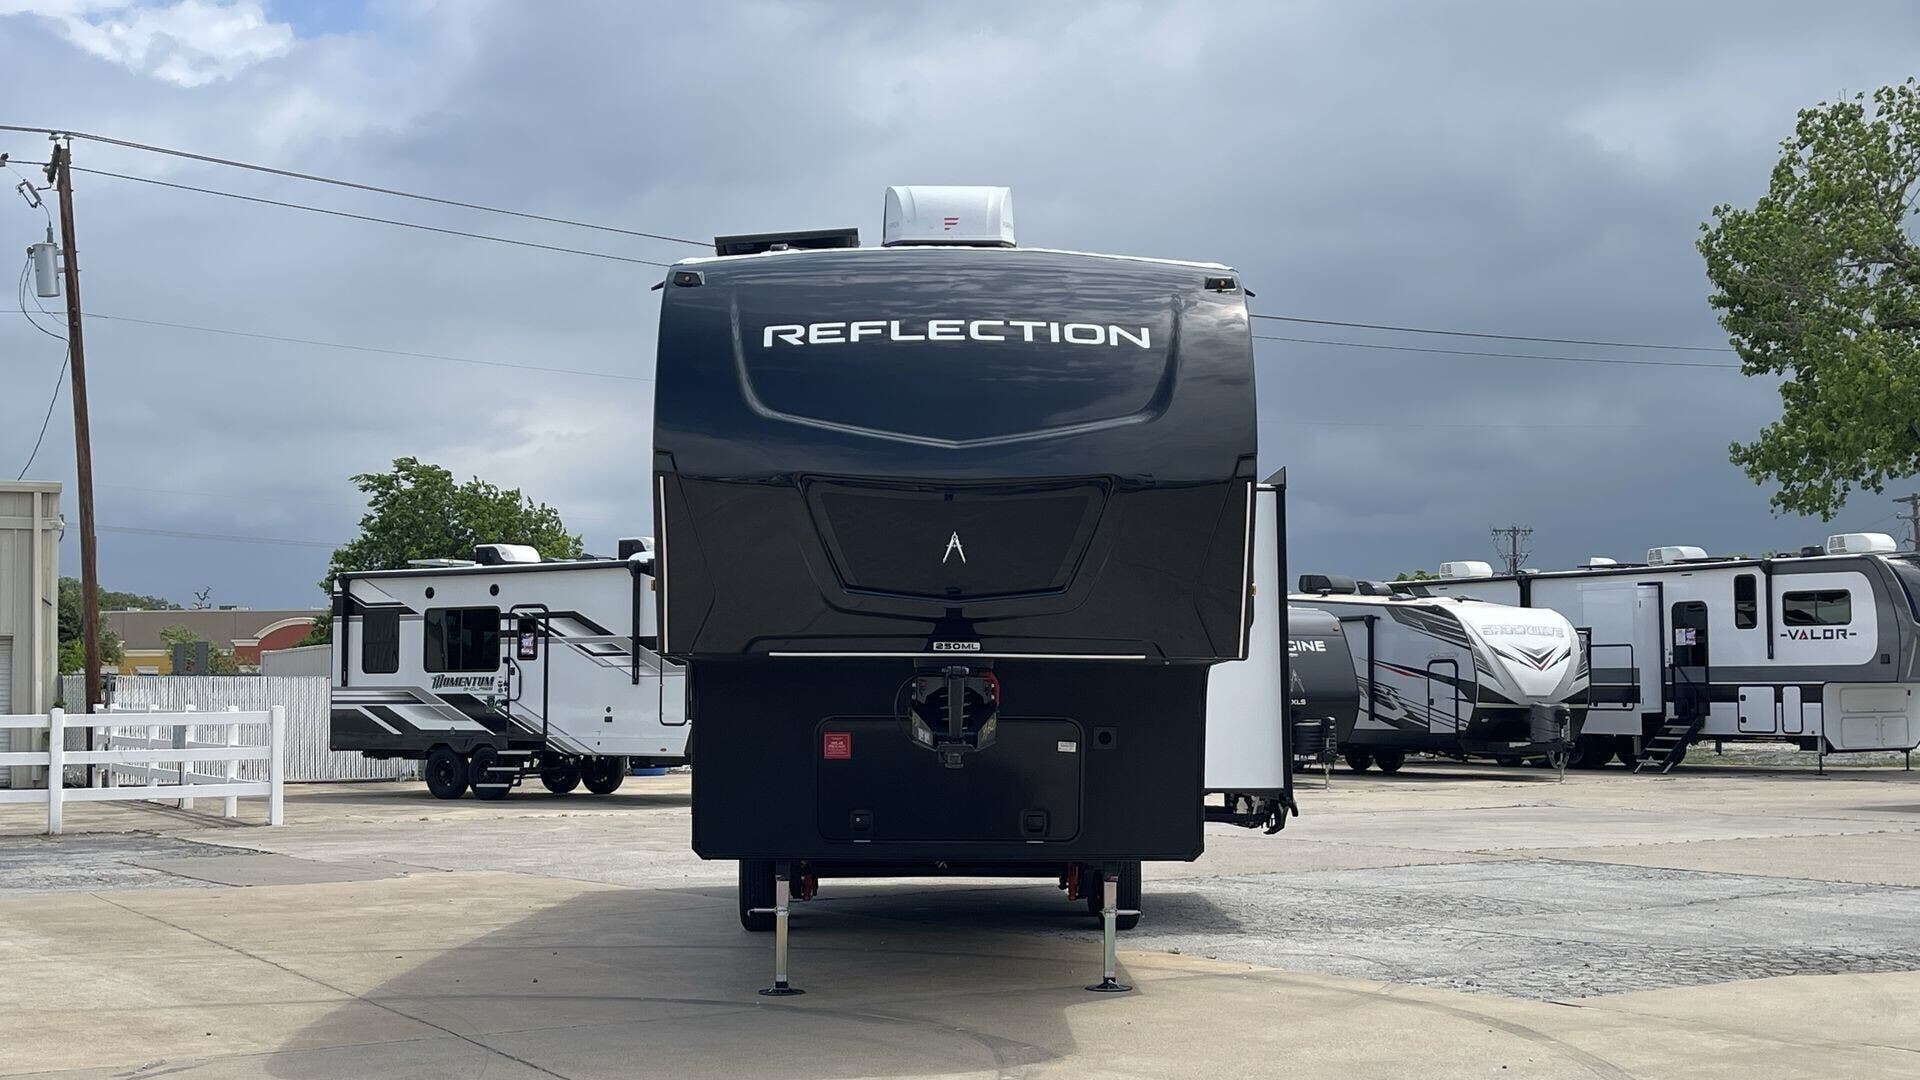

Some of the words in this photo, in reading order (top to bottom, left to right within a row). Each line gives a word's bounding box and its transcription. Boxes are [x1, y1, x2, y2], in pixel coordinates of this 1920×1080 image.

[763, 319, 1152, 349] REFLECTION
[935, 642, 979, 650] 250ML
[1288, 640, 1327, 652] GINE
[432, 674, 495, 689] MOMENTUM
